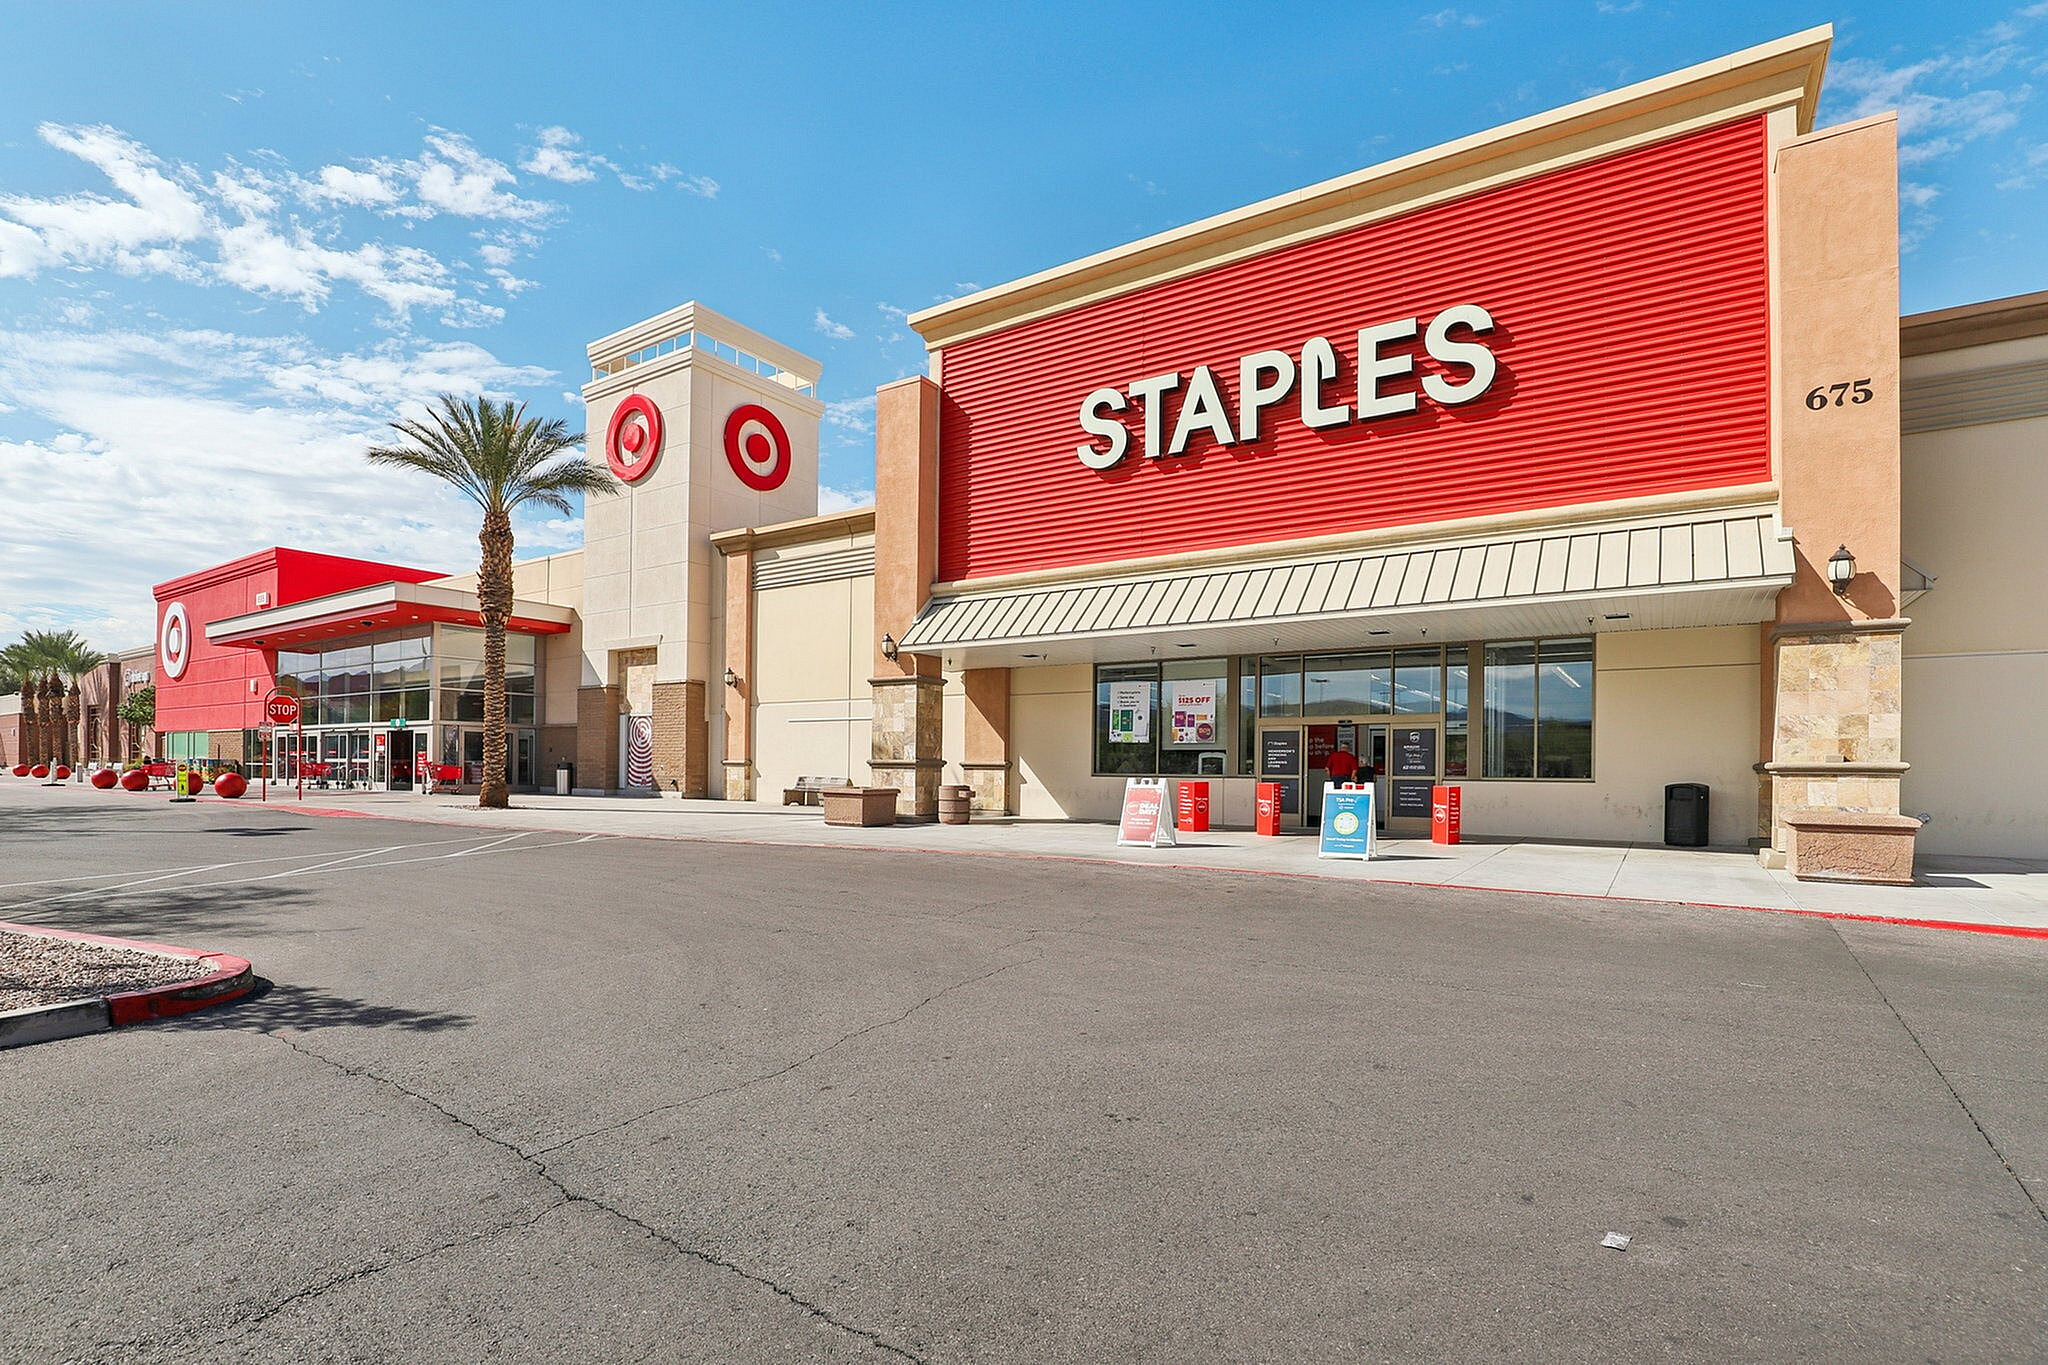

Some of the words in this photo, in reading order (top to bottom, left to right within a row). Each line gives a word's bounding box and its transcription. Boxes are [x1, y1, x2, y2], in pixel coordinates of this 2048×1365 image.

[1077, 304, 1497, 470] STAPLES
[1805, 377, 1874, 411] 675
[269, 703, 297, 716] STOP
[1178, 696, 1194, 704] $125
